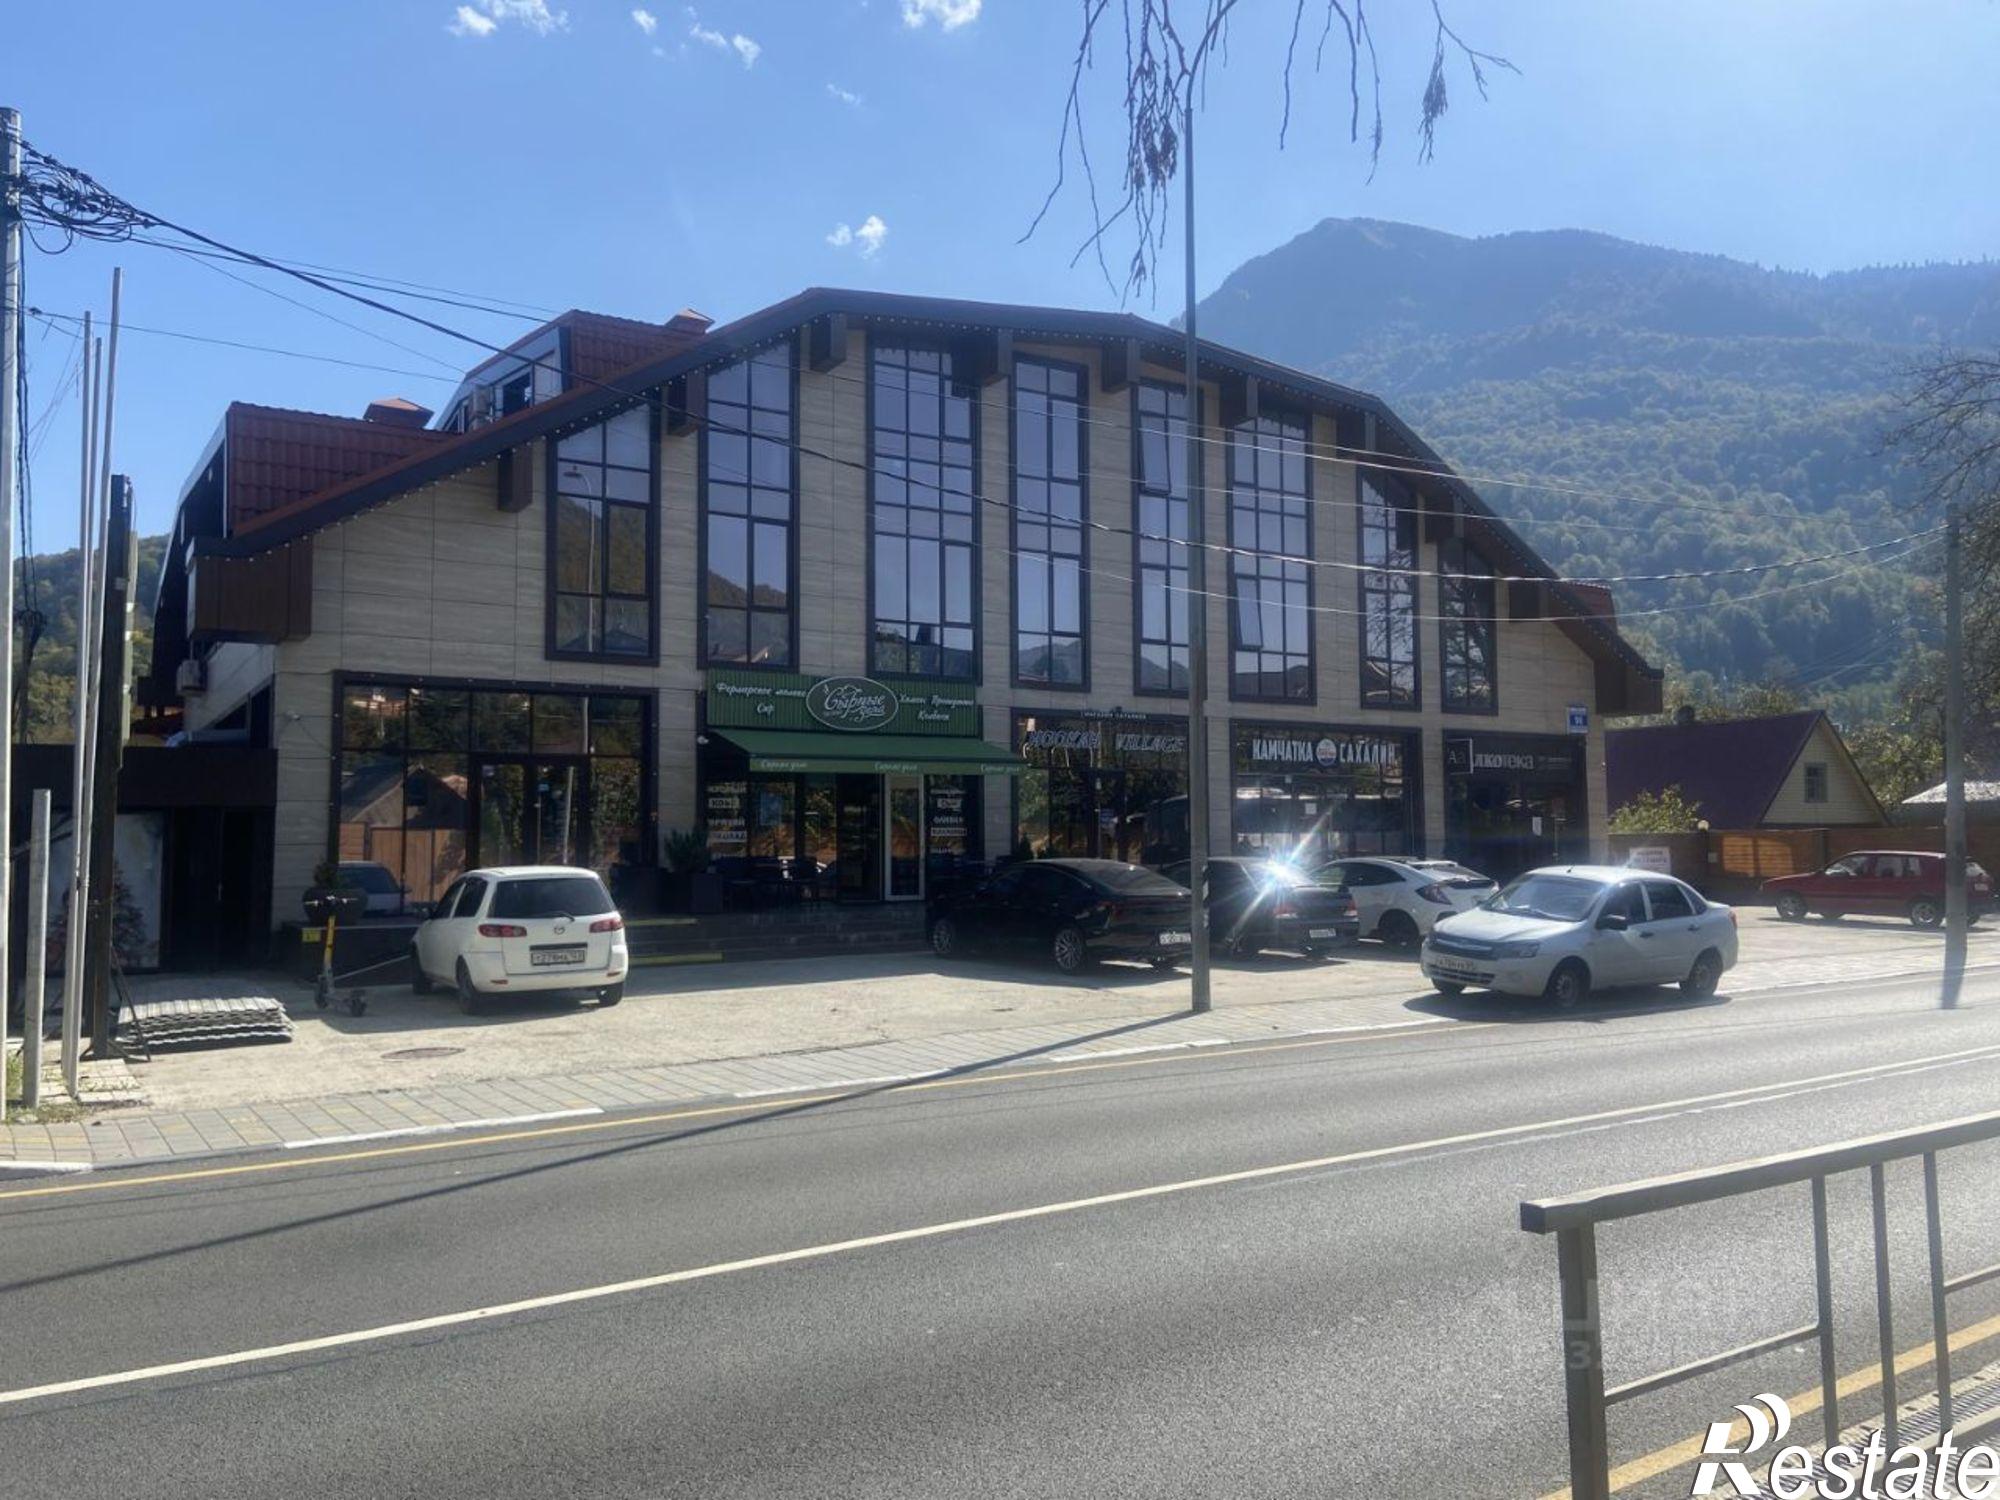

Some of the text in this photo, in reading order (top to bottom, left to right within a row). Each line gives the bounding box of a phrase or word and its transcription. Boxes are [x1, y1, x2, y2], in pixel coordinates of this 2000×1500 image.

[1115, 733, 1187, 752] VILLAGE
[1252, 738, 1396, 764] КАМЧАТКА САХАЛИН
[1474, 754, 1534, 770] лкотека
